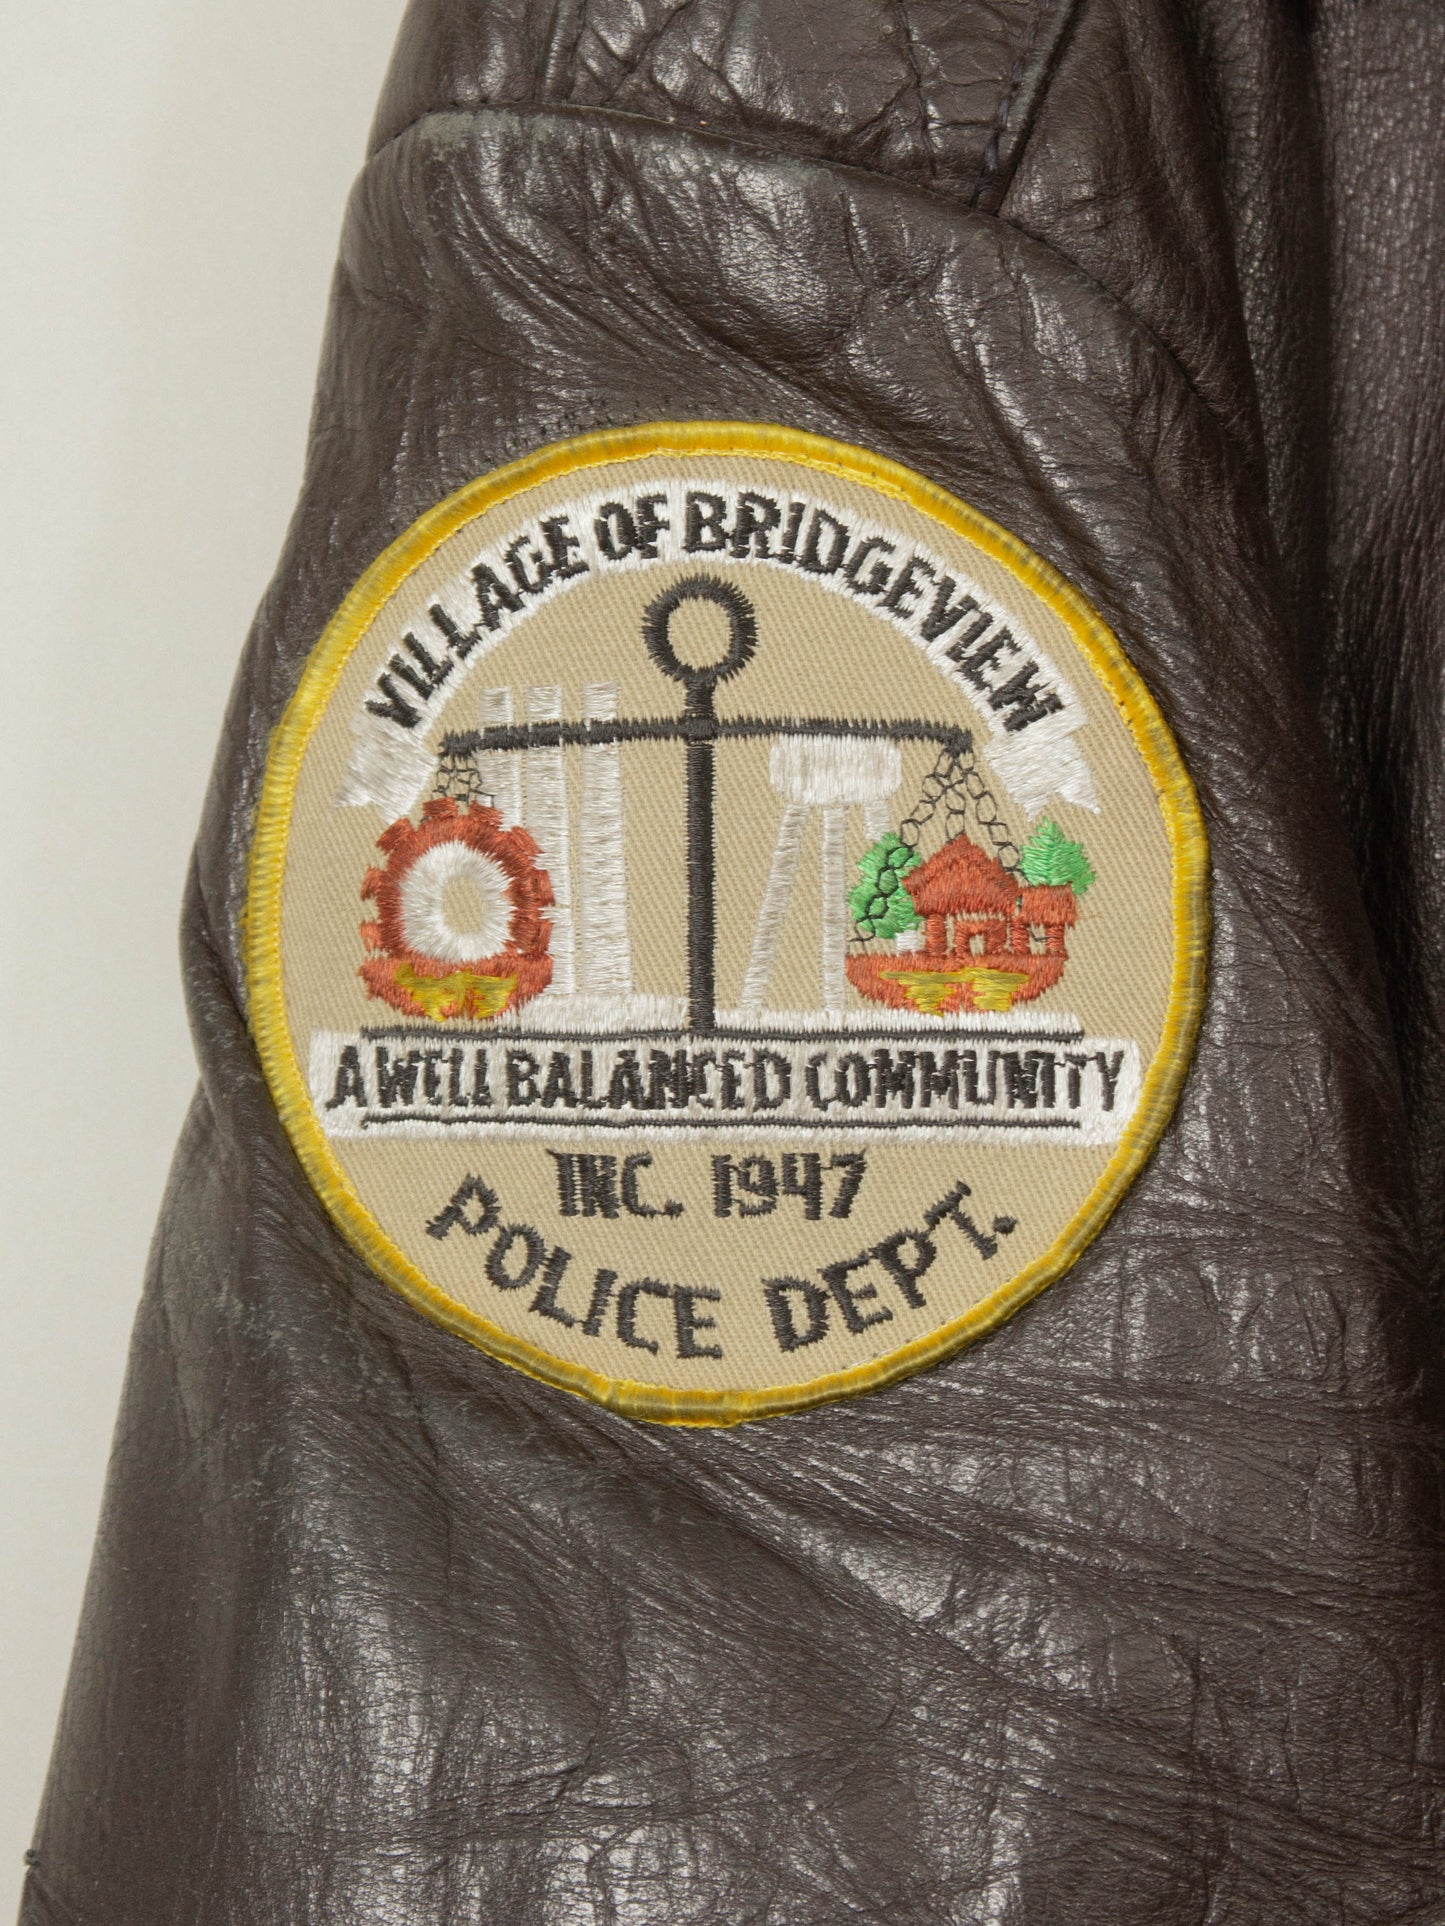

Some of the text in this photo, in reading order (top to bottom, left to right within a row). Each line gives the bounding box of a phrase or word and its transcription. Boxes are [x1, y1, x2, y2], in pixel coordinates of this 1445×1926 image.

[364, 491, 1064, 732] VILLAGE OF BRIDGEVIEW
[326, 1045, 1125, 1111] A WELL BALANCED COMMUNITY
[548, 1150, 866, 1220] INC. 1947
[426, 1172, 1018, 1360] POLICE DEPT.
